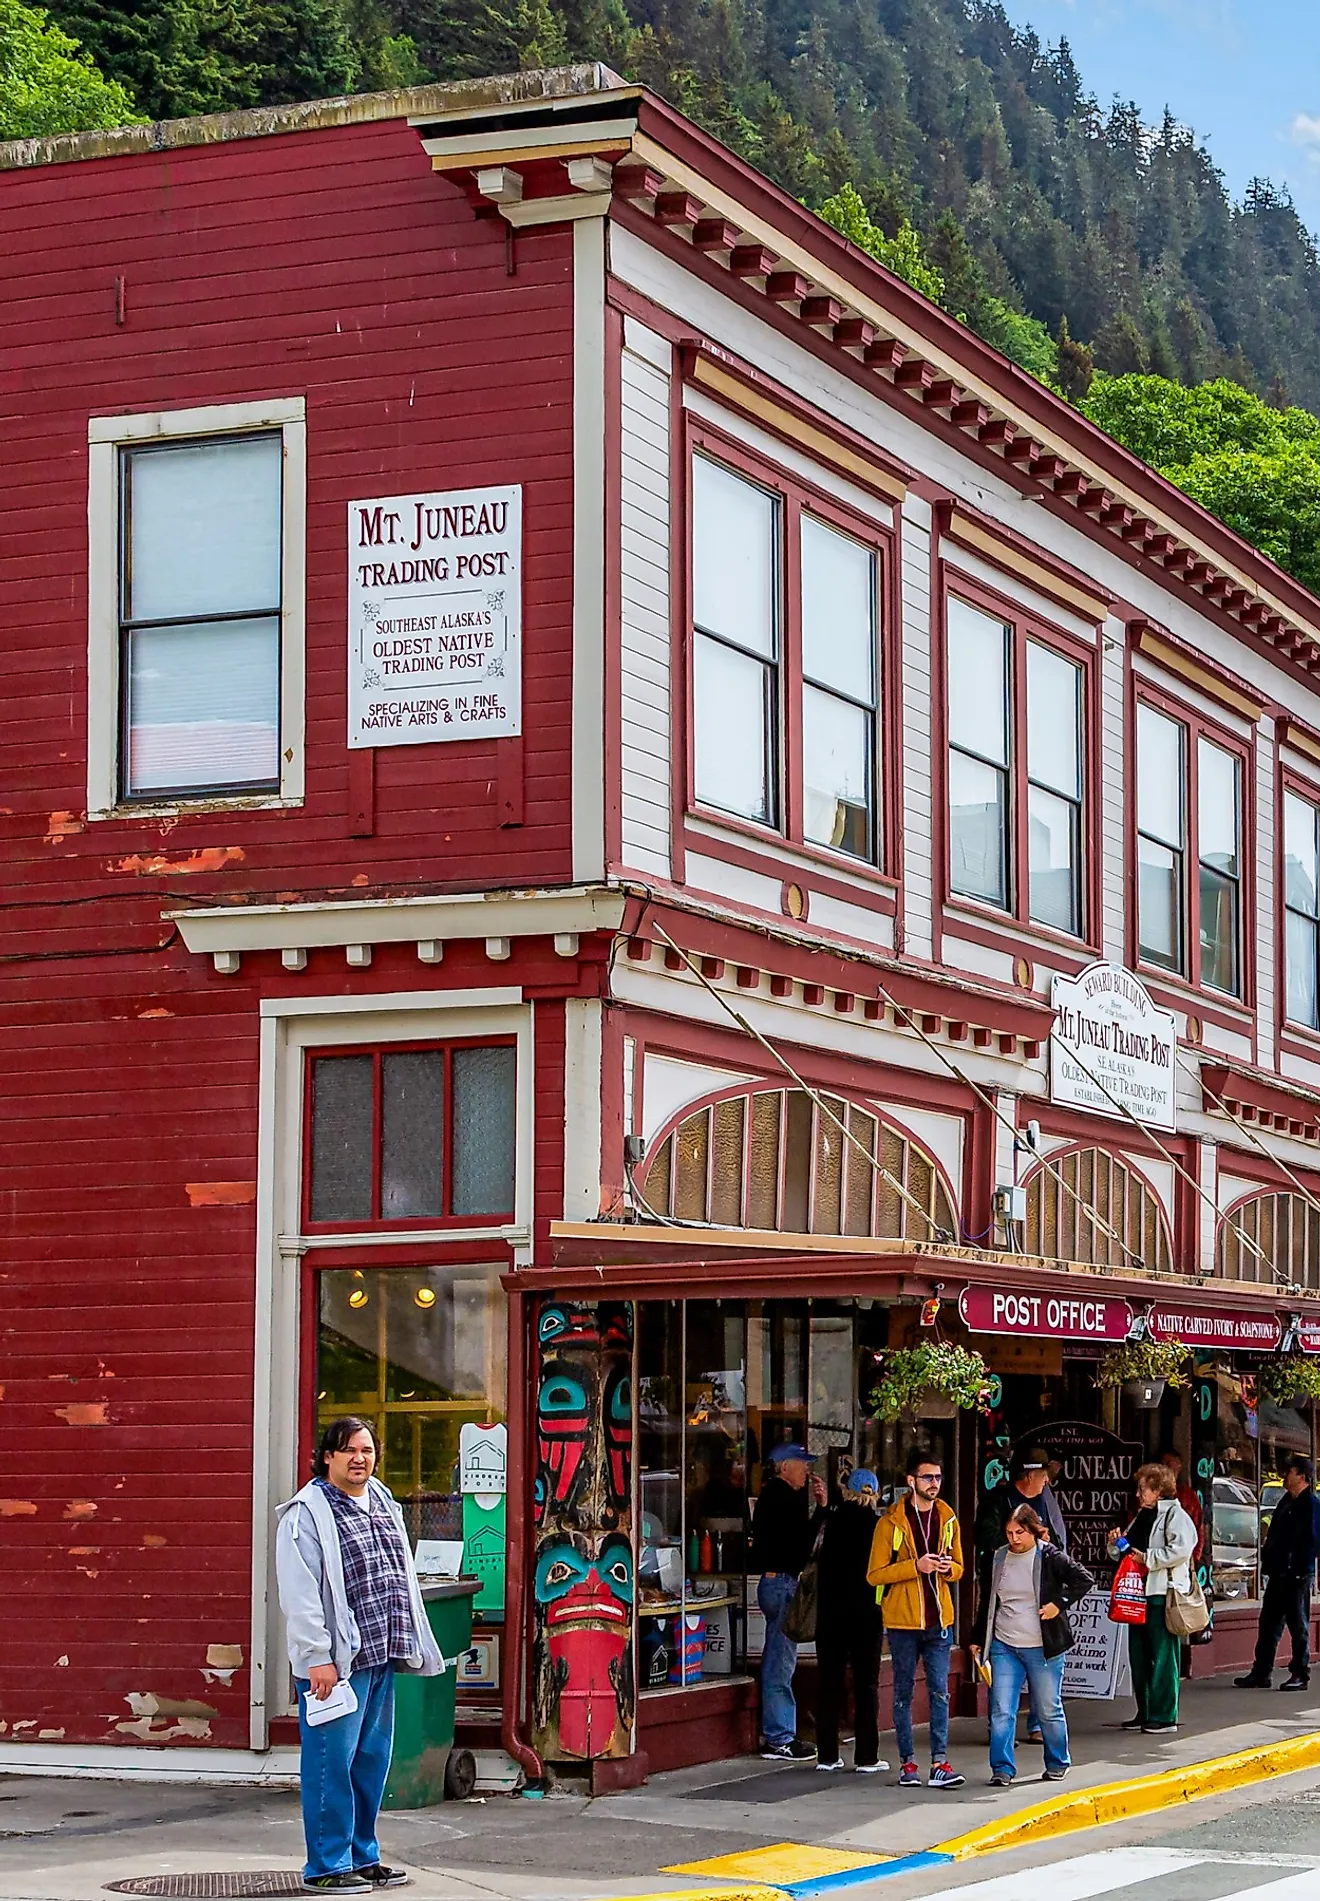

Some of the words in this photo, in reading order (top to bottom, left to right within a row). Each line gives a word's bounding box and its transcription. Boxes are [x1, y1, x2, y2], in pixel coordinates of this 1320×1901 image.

[411, 501, 509, 551] JUNEAU
[358, 557, 448, 588] TRADING
[456, 551, 509, 578] POST
[376, 615, 437, 635] SOUTHEAST
[440, 611, 492, 630] ALASKA'S
[373, 638, 433, 658] OLDEST
[438, 632, 494, 653] NATIVE
[382, 655, 444, 675] TRADING
[450, 653, 485, 669] POST
[369, 697, 449, 716] SPECIALIZING
[455, 697, 468, 709] IN
[474, 694, 499, 708] FINE
[361, 714, 402, 729] NATIVE
[408, 710, 437, 725] ARTS
[444, 711, 453, 722] &
[462, 707, 507, 721] CRAFTS
[1113, 974, 1146, 1018] BUILDING
[1075, 1010, 1110, 1050] JUNEAU
[1111, 1021, 1149, 1062] TRADING
[1151, 1034, 1170, 1068] POST
[1120, 1078, 1149, 1100] TRADING
[1151, 1086, 1167, 1104] POST
[993, 1293, 1041, 1326] POST
[1047, 1299, 1106, 1333] OFFICE
[1157, 1314, 1183, 1333] NATIVE
[1184, 1316, 1213, 1335] CARVED
[1214, 1319, 1234, 1336] IVORY
[1240, 1322, 1273, 1339] SOAPSTONE
[1057, 1456, 1133, 1482] UNEAU
[1091, 1491, 1132, 1512] POST
[1068, 1614, 1101, 1628] OFT
[1099, 1635, 1108, 1645] &
[1074, 1661, 1083, 1669] at
[1085, 1661, 1107, 1672] work
